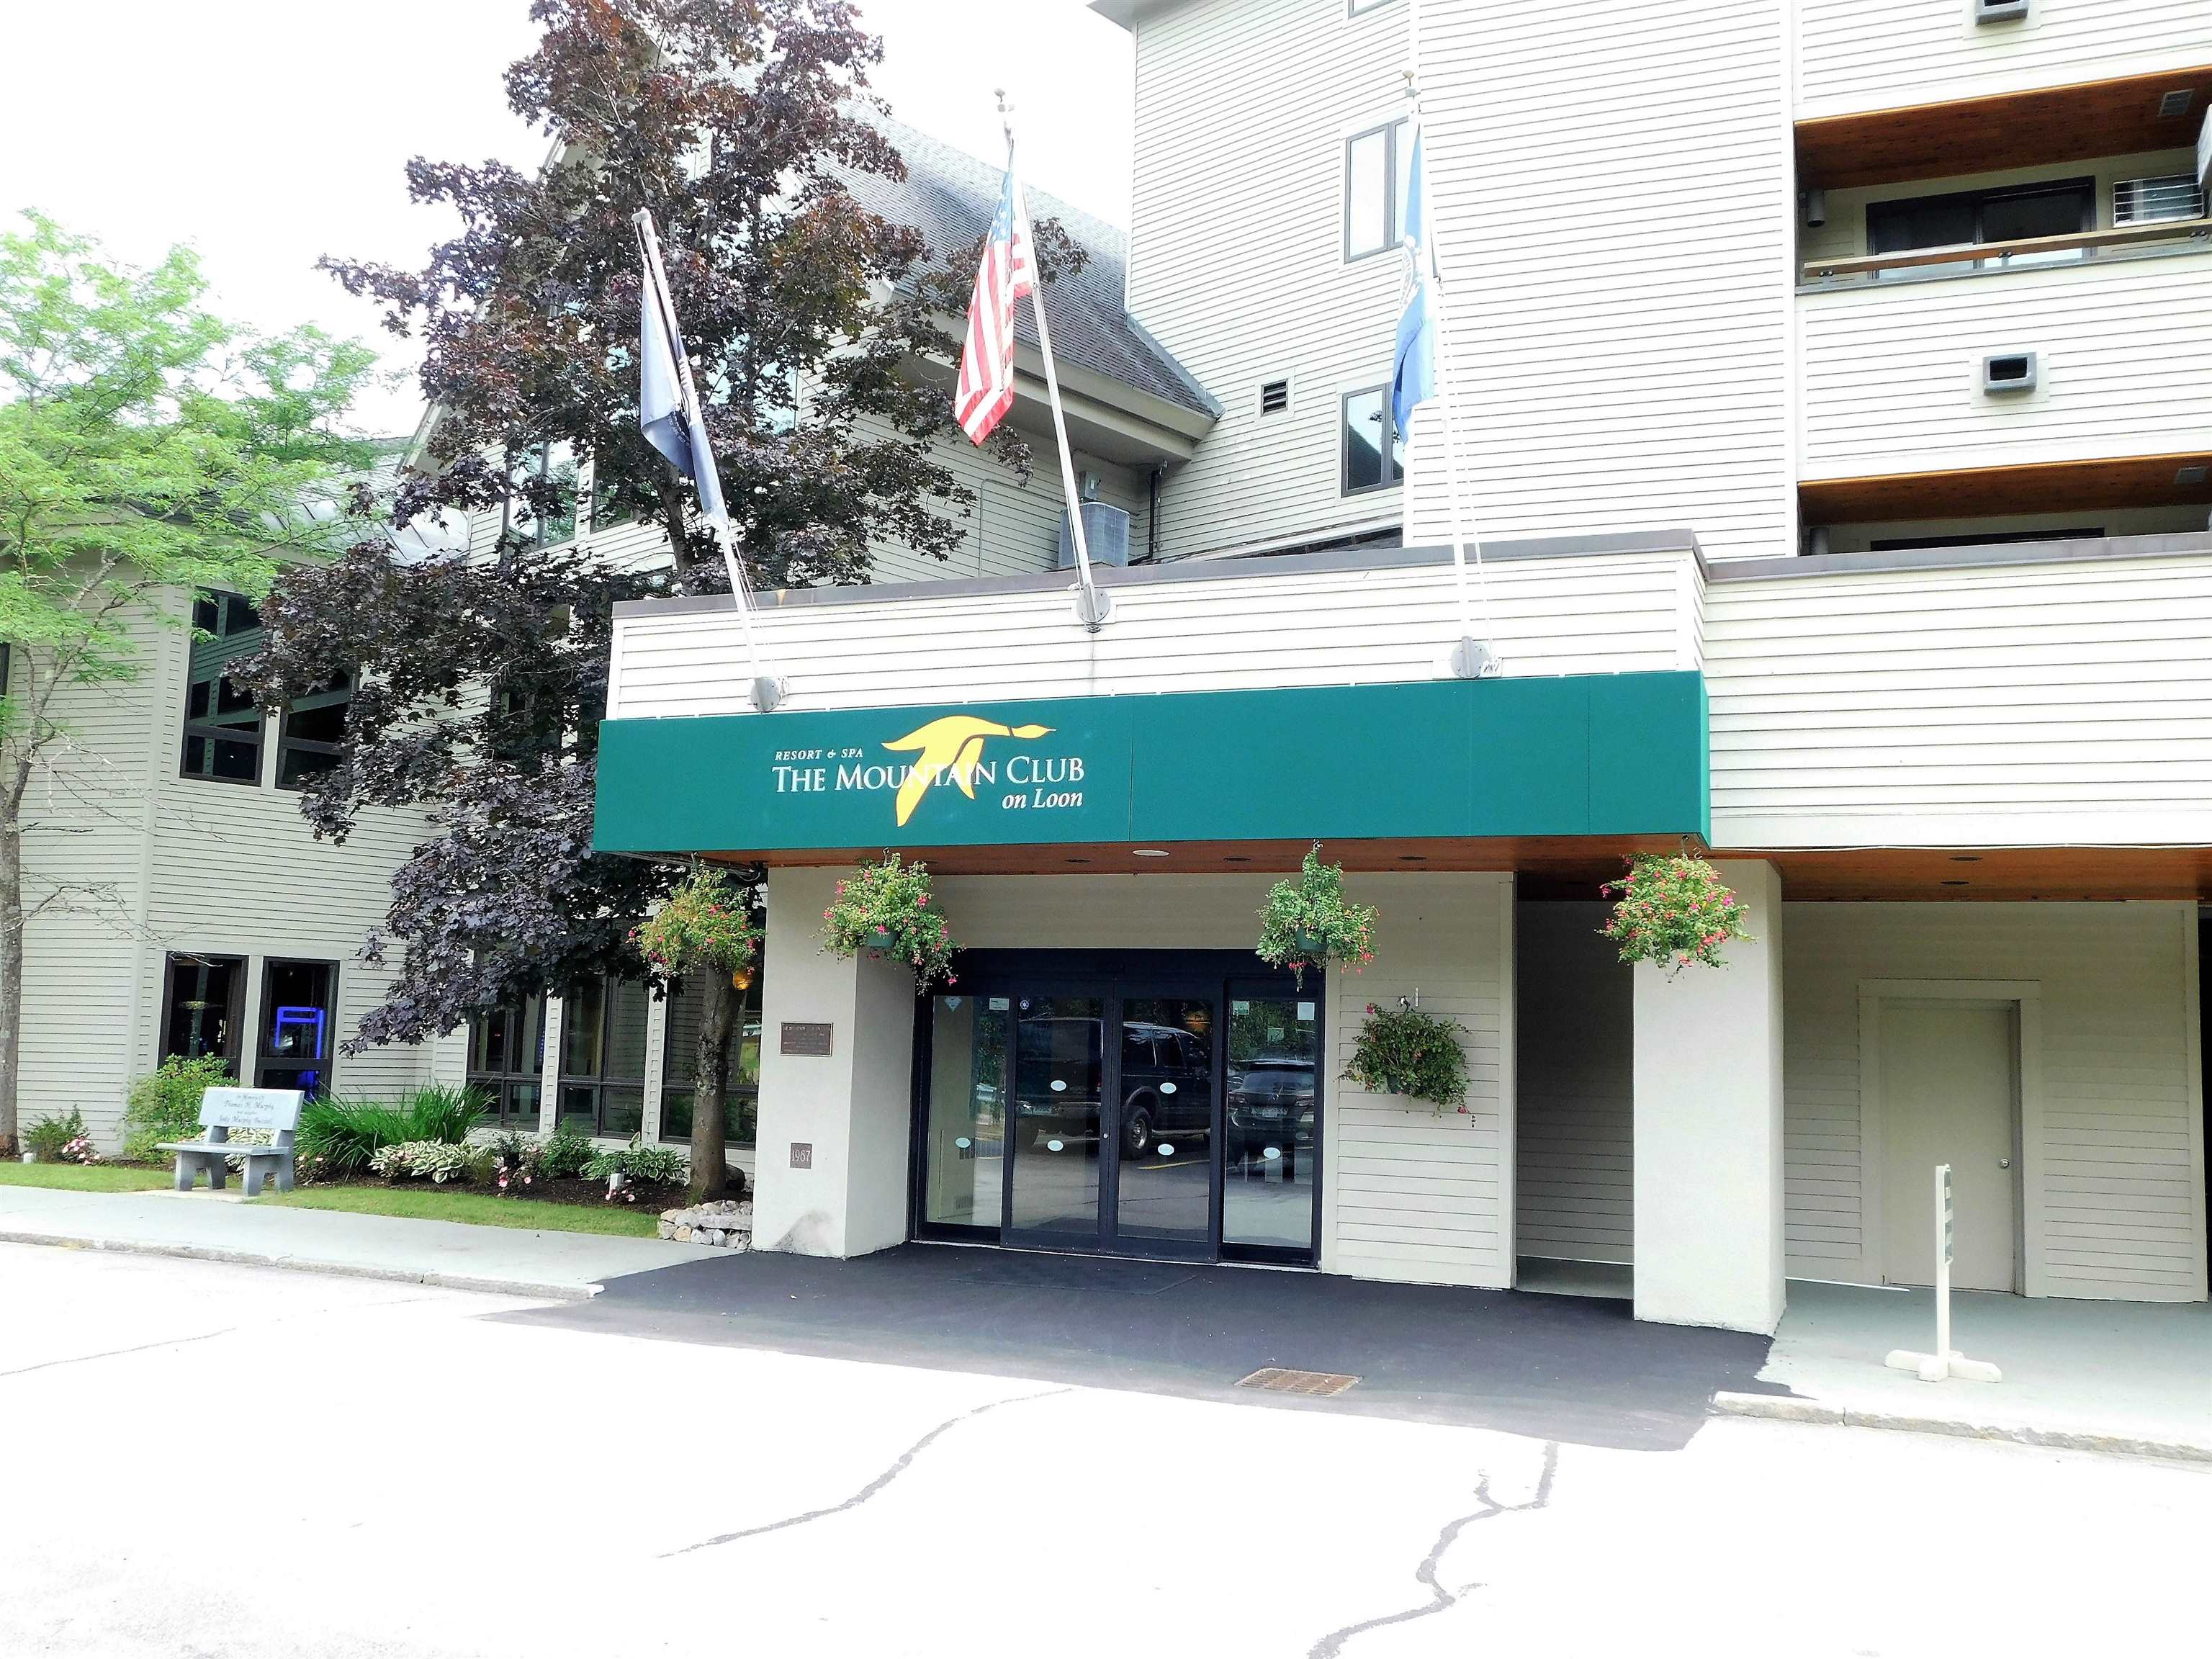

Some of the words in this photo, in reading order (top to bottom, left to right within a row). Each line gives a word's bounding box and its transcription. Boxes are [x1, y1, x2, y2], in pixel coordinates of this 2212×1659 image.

[774, 749, 822, 761] RESORT
[827, 749, 837, 759] &
[841, 747, 864, 758] SPA
[772, 765, 826, 793] THE
[835, 761, 997, 791] MOUNTAIN
[1007, 755, 1084, 784] CLUB
[1002, 793, 1028, 809] on
[1031, 788, 1083, 809] Loon
[792, 1149, 811, 1162] 1987
